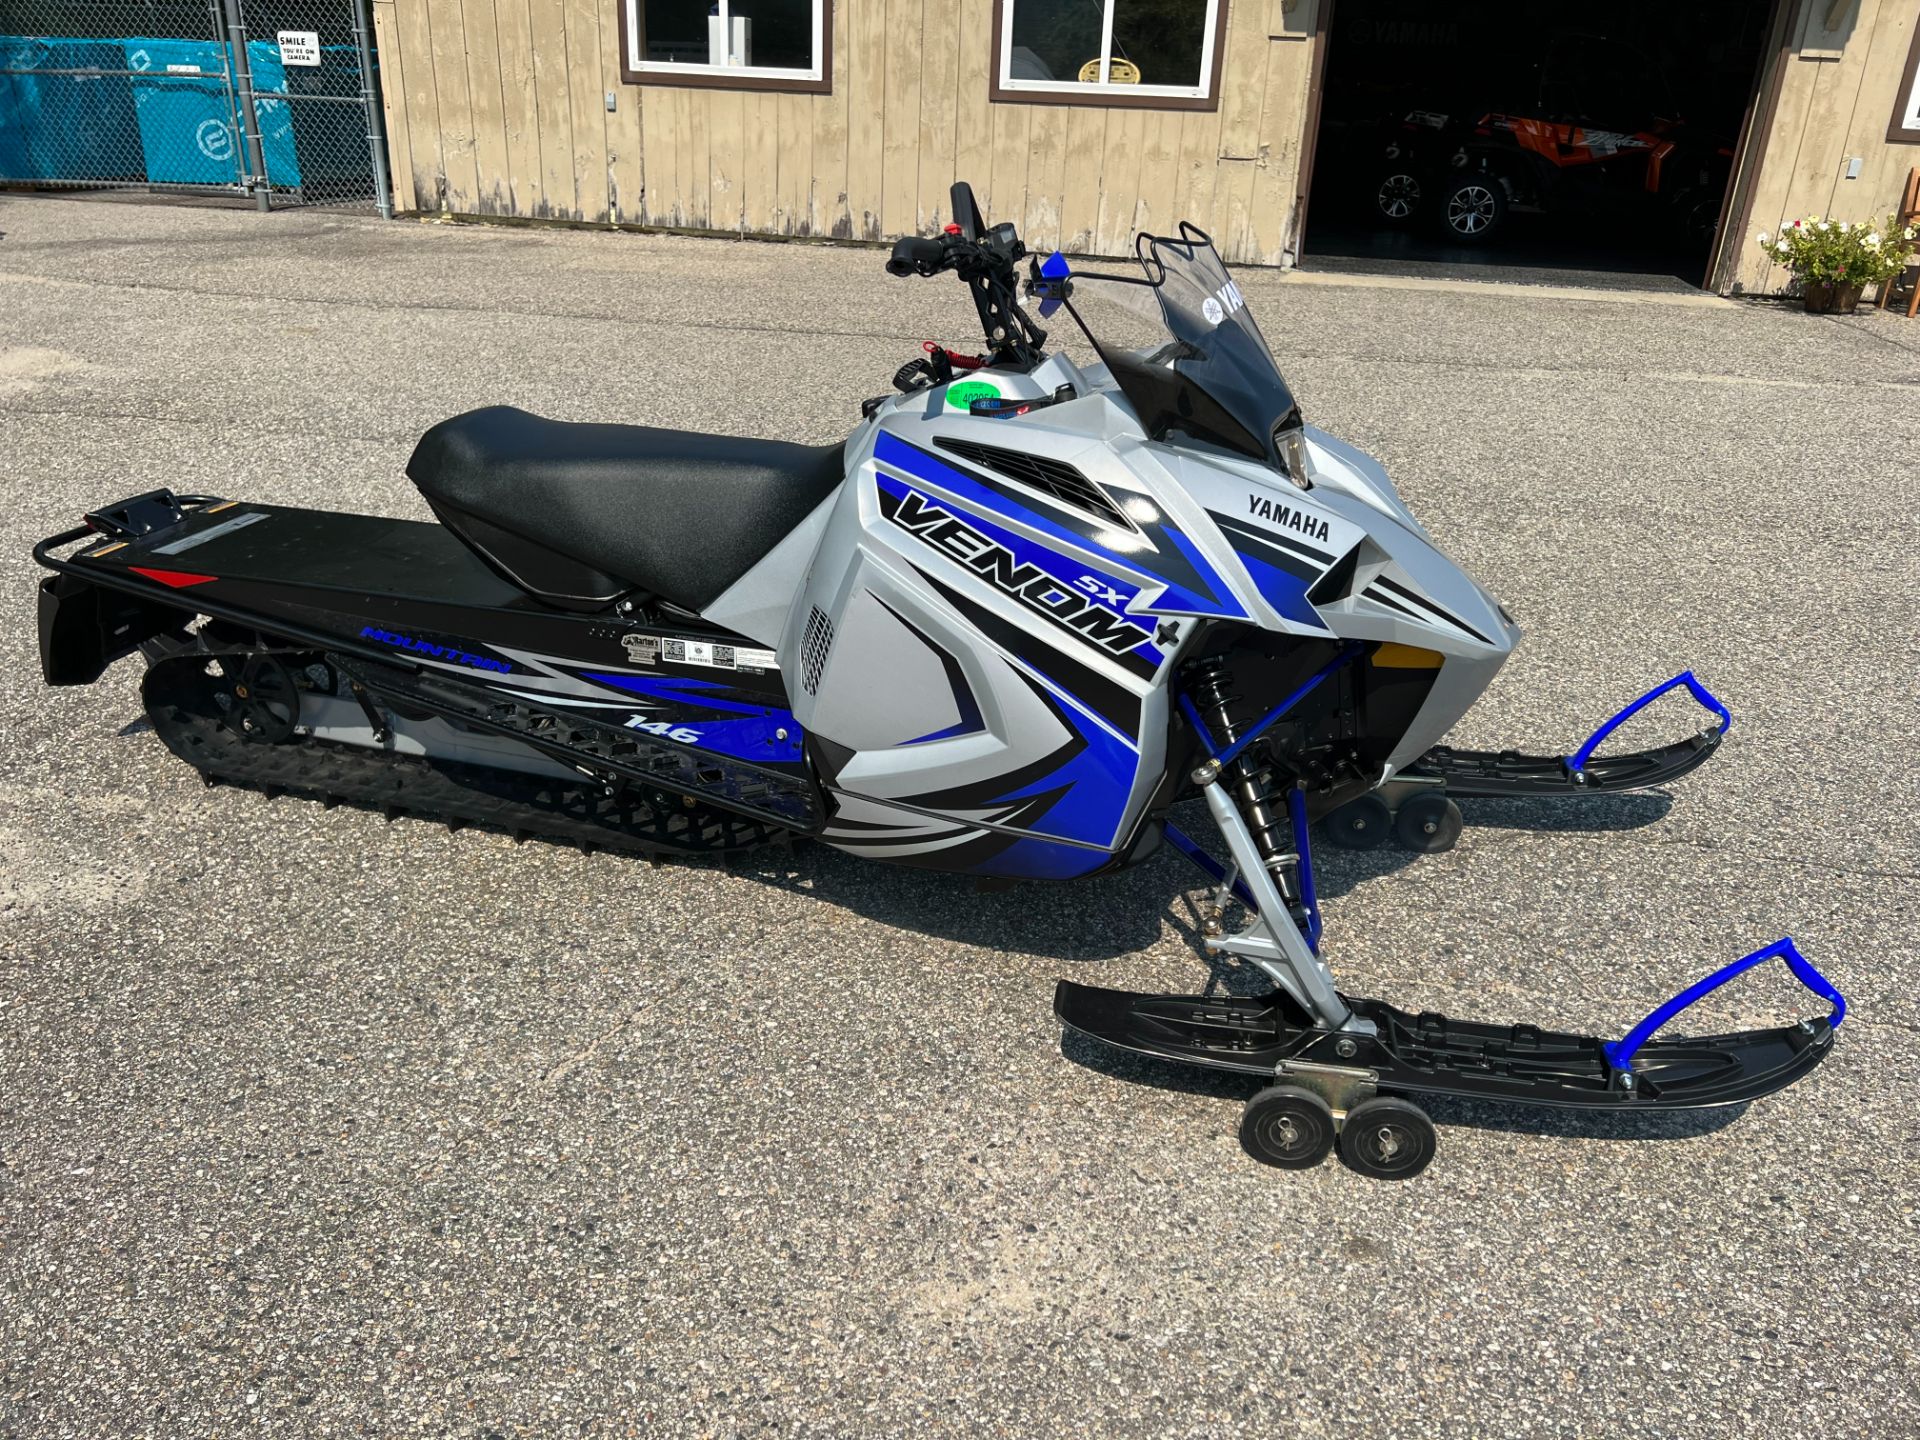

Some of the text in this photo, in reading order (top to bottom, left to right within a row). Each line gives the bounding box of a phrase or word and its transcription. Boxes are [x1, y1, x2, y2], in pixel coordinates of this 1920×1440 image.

[280, 37, 306, 46] SMILE
[1374, 18, 1459, 47] YAMAHA
[1249, 493, 1329, 543] YAMAHA
[893, 489, 1153, 655] VENOM
[1072, 575, 1131, 606] SX
[359, 625, 513, 675] MOUNTAIN
[623, 713, 705, 744] 146
